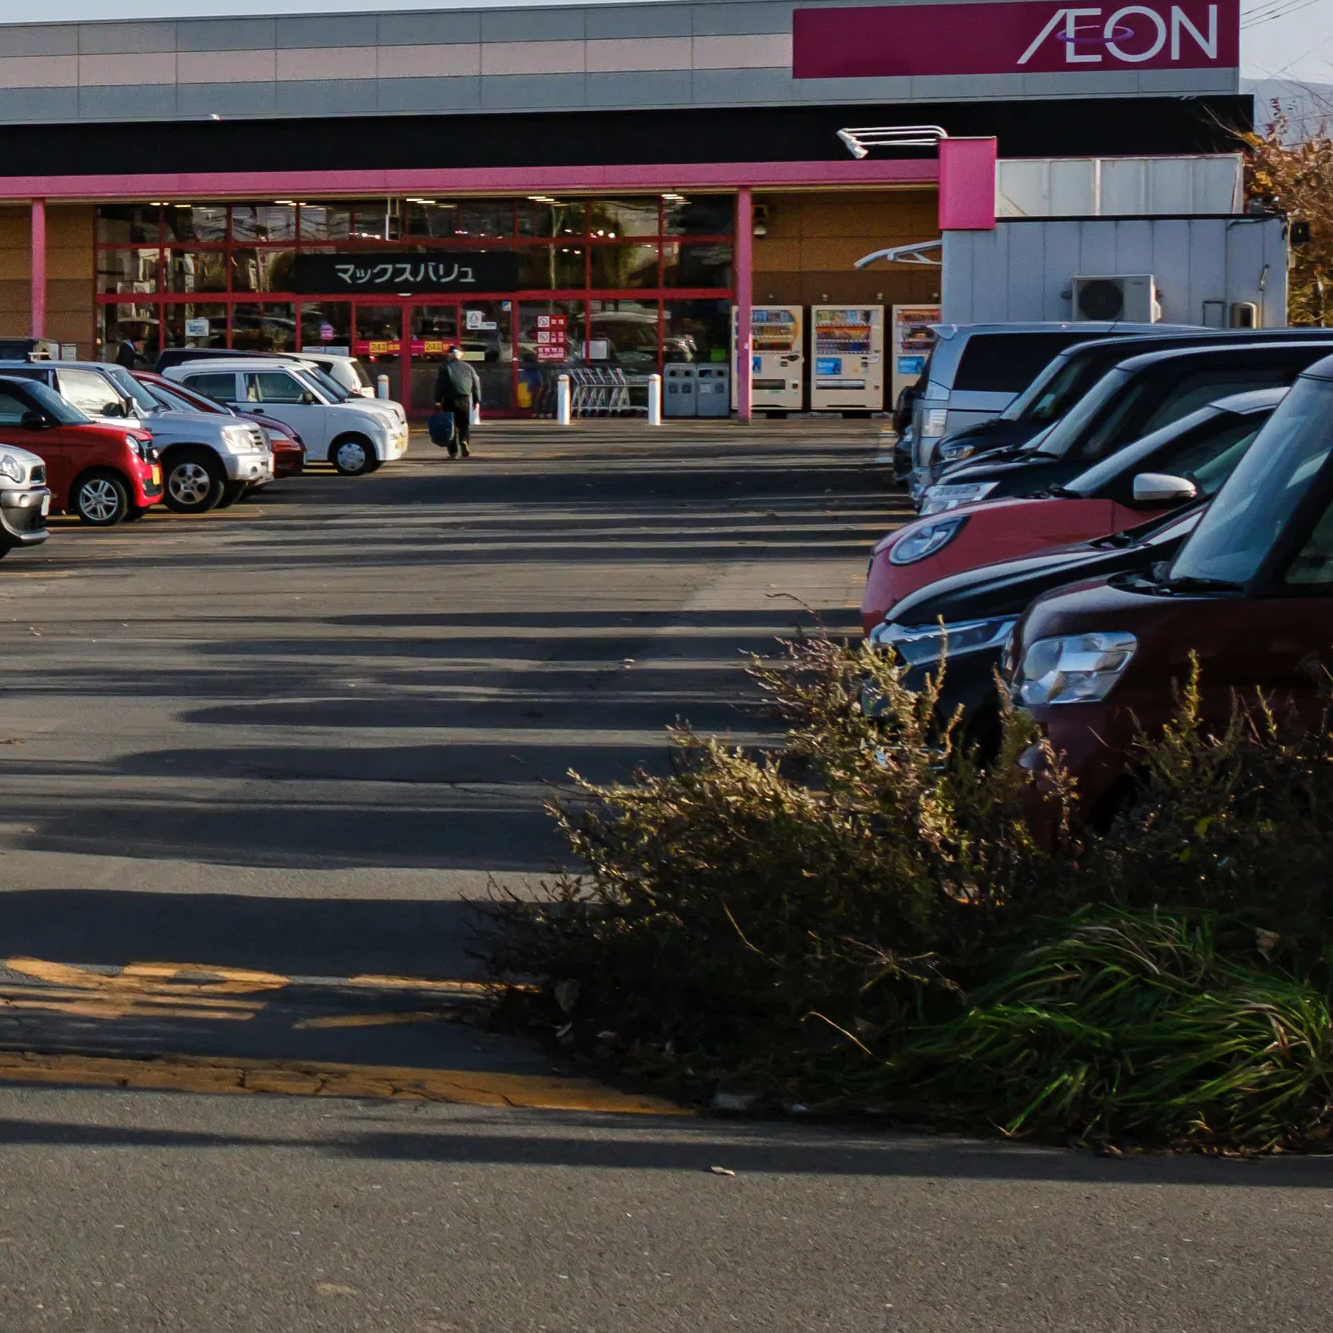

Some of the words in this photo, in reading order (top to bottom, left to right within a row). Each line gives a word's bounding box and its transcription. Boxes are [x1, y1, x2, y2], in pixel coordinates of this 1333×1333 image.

[335, 262, 476, 284] マックスバリュ
